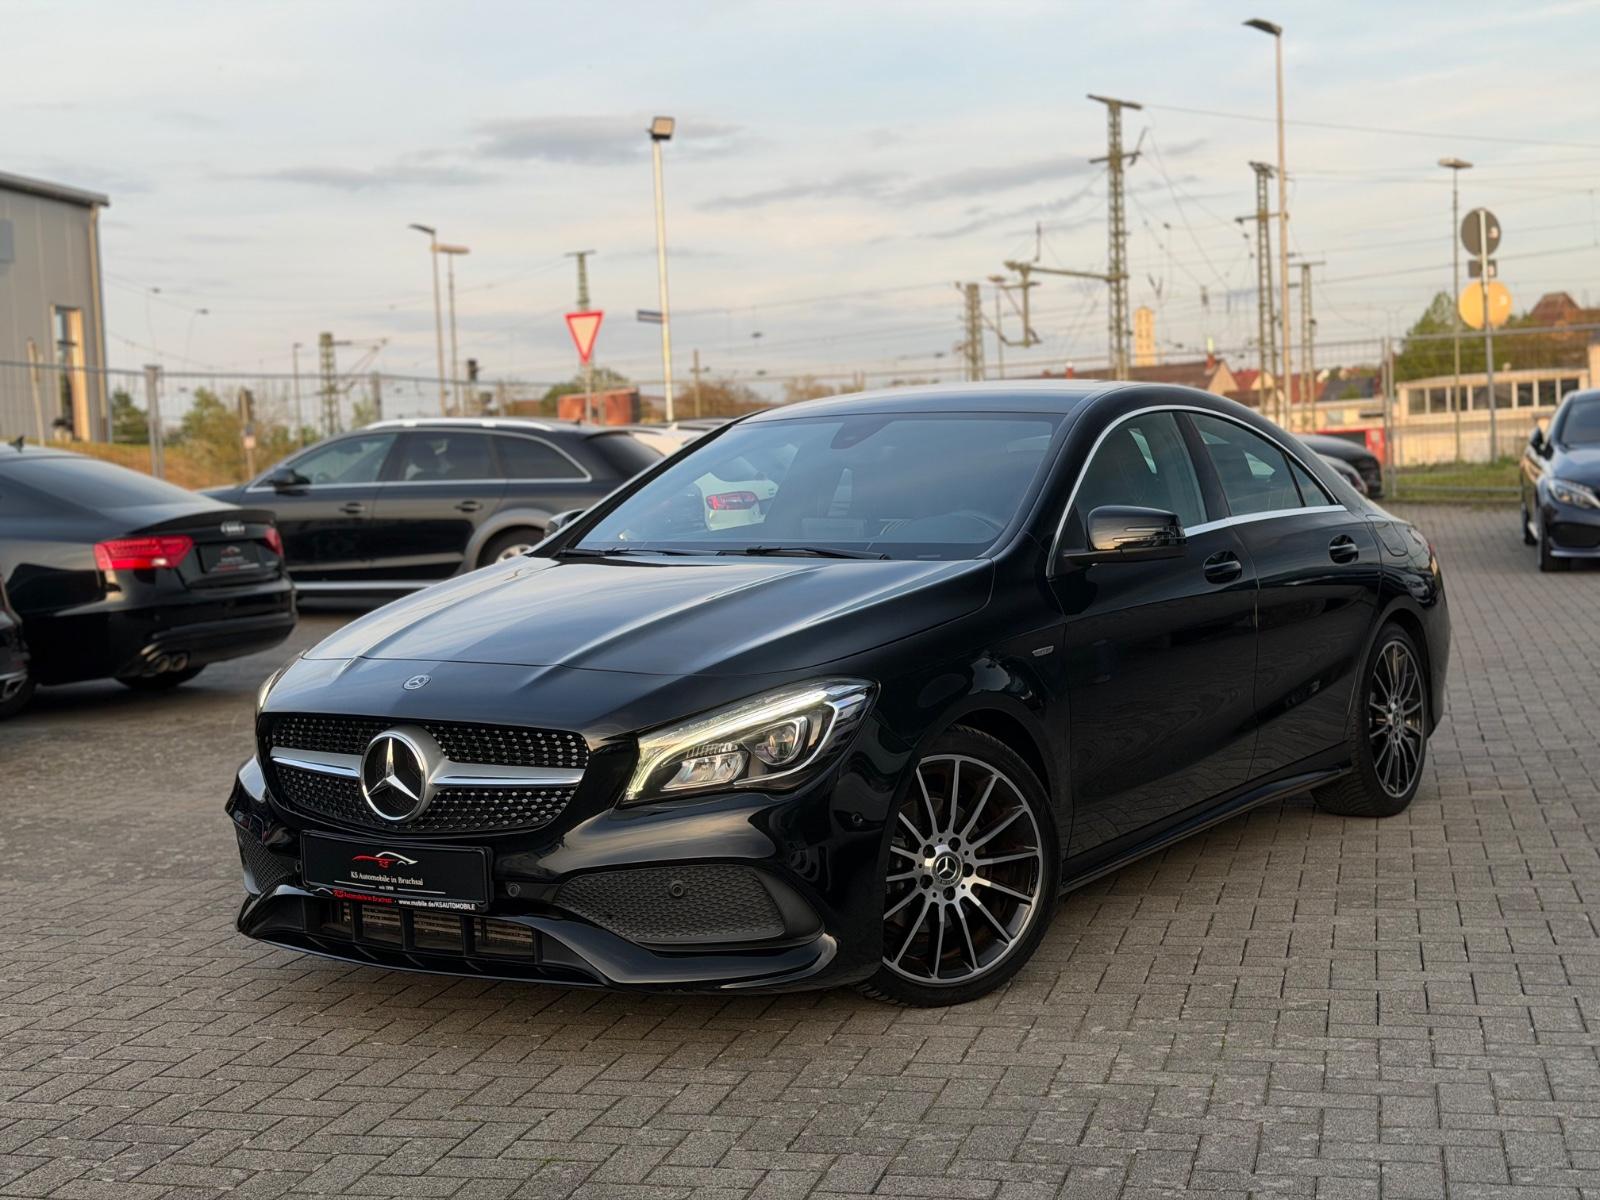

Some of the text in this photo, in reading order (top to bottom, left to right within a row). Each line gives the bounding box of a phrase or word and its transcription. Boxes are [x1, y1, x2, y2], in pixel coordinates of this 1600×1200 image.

[350, 871, 424, 886] KS Automobile in Bruchsal
